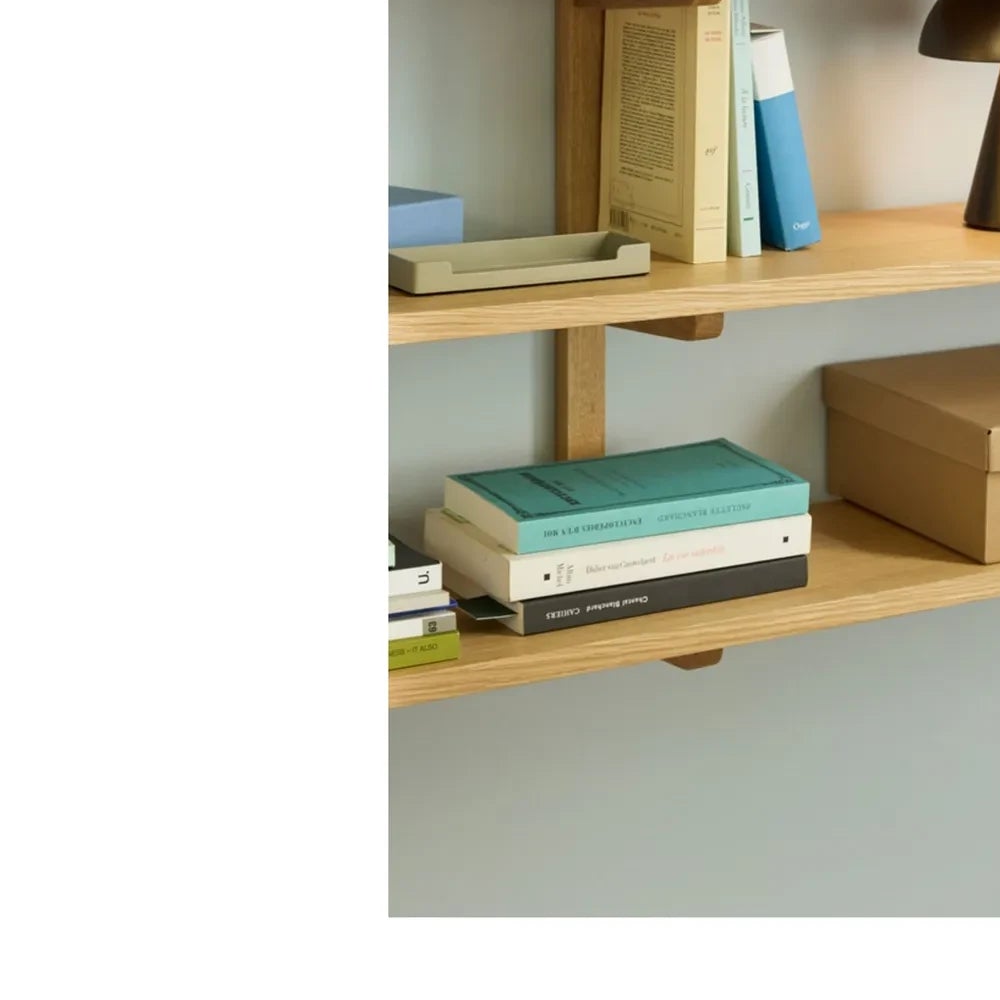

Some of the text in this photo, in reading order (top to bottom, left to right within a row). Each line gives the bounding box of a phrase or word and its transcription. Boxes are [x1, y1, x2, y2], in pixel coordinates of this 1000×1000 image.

[586, 595, 649, 613] Chantal Blanchard
[546, 607, 580, 620] CAHIERS
